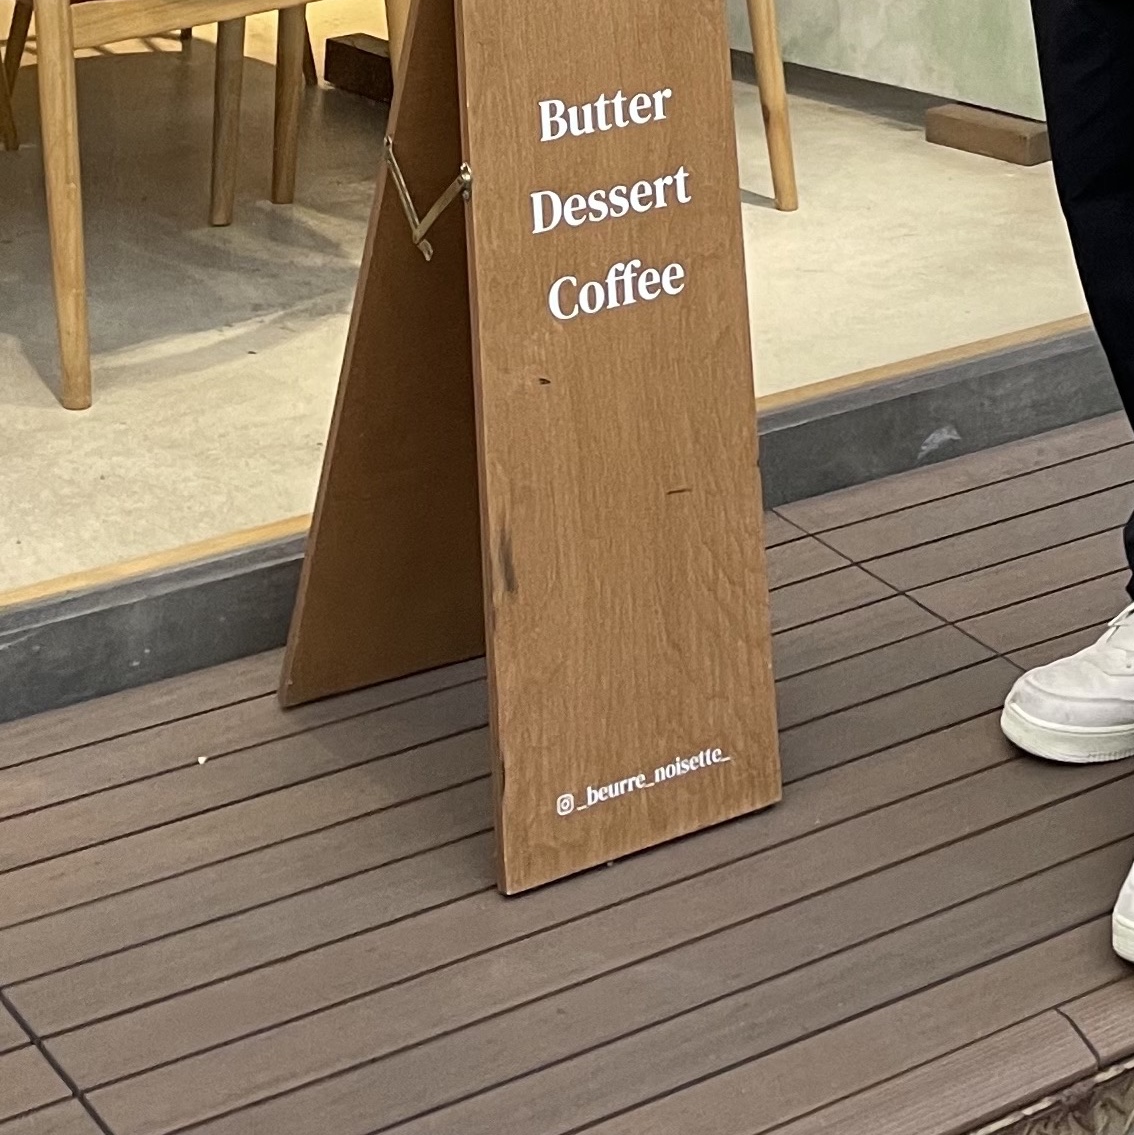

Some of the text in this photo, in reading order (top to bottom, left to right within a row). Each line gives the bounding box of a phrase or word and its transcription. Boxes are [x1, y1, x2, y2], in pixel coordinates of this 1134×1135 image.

[538, 88, 672, 142] Butter
[530, 165, 692, 234] Dessert
[548, 259, 686, 320] Coffee
[577, 747, 731, 811] _beurre_noisette_
